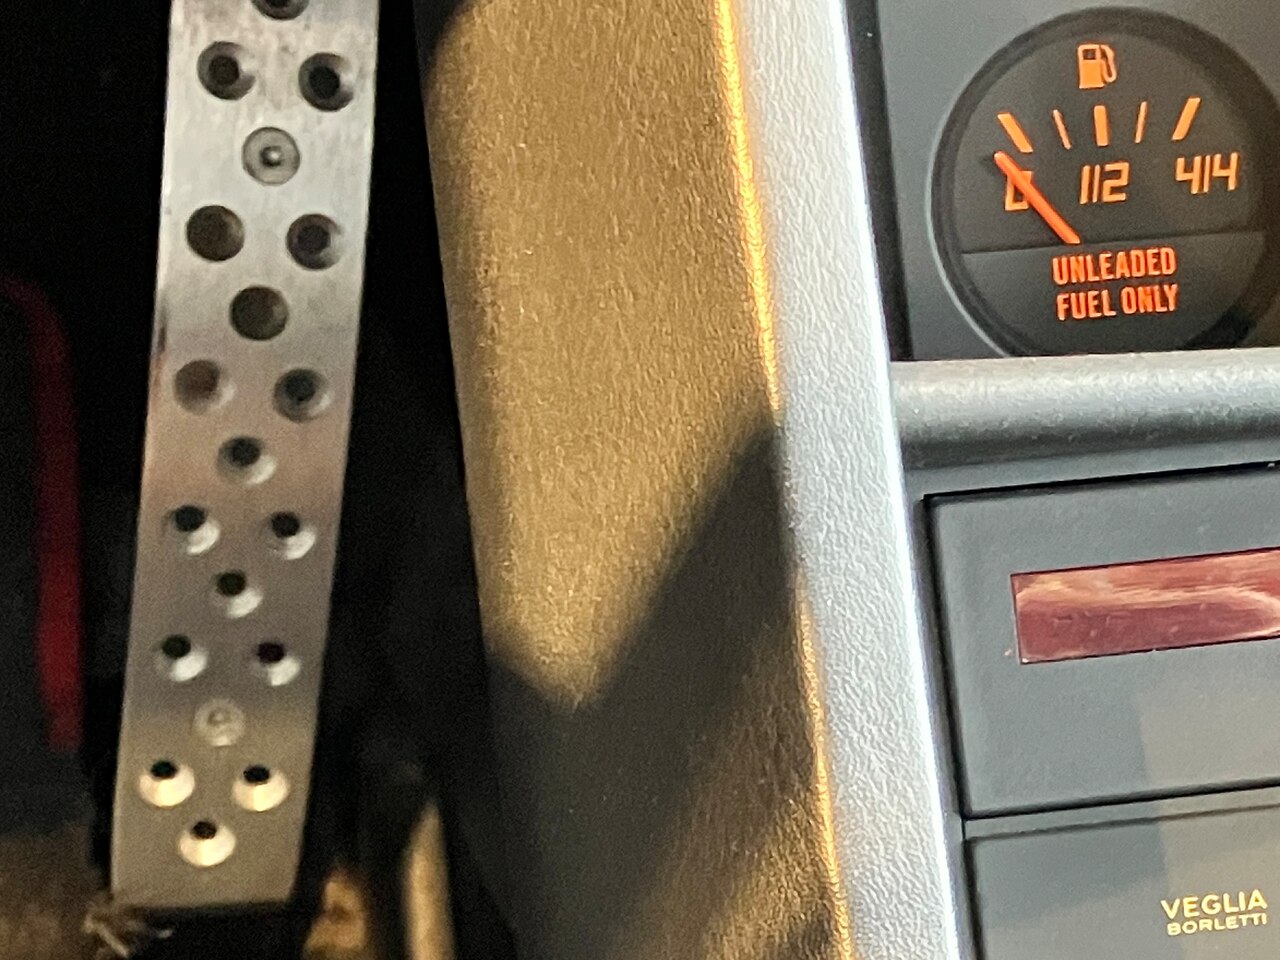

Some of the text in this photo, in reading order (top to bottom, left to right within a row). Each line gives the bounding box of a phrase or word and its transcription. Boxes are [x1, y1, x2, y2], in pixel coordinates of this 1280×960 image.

[1052, 246, 1176, 286] UNLEADED
[1056, 283, 1179, 321] FUEL ONLY
[1160, 888, 1268, 920] VEGLIA
[1166, 912, 1268, 936] BORLETTI
